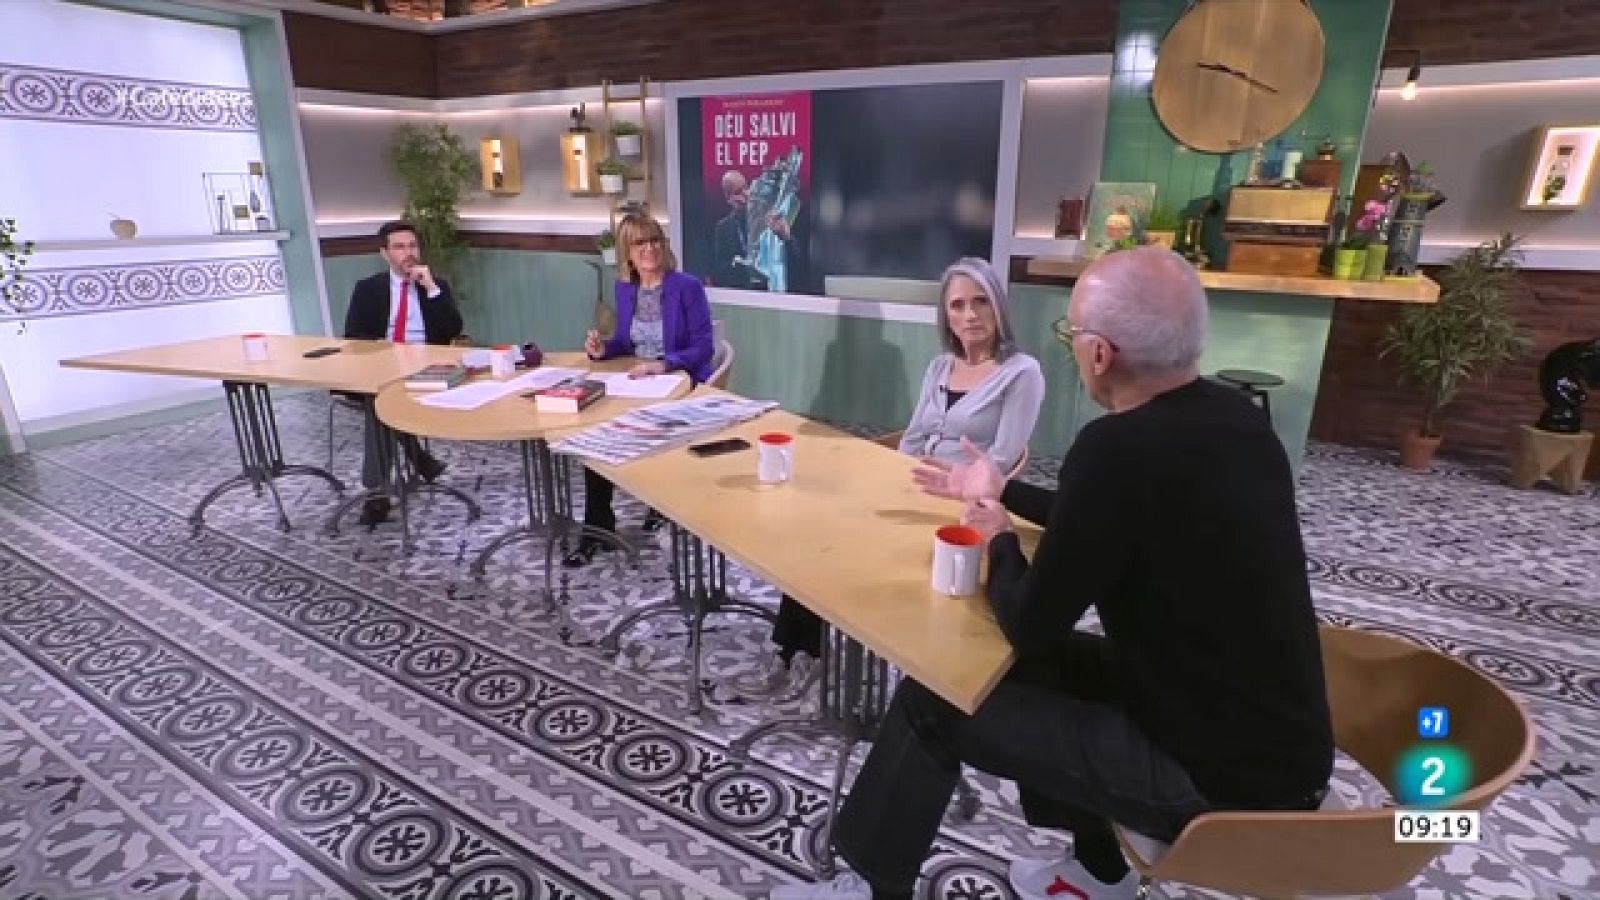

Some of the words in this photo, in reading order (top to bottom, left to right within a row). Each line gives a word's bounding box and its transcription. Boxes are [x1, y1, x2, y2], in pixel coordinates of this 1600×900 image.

[750, 111, 796, 137] SALVI
[715, 141, 733, 166] EL
[739, 140, 769, 166] PEP
